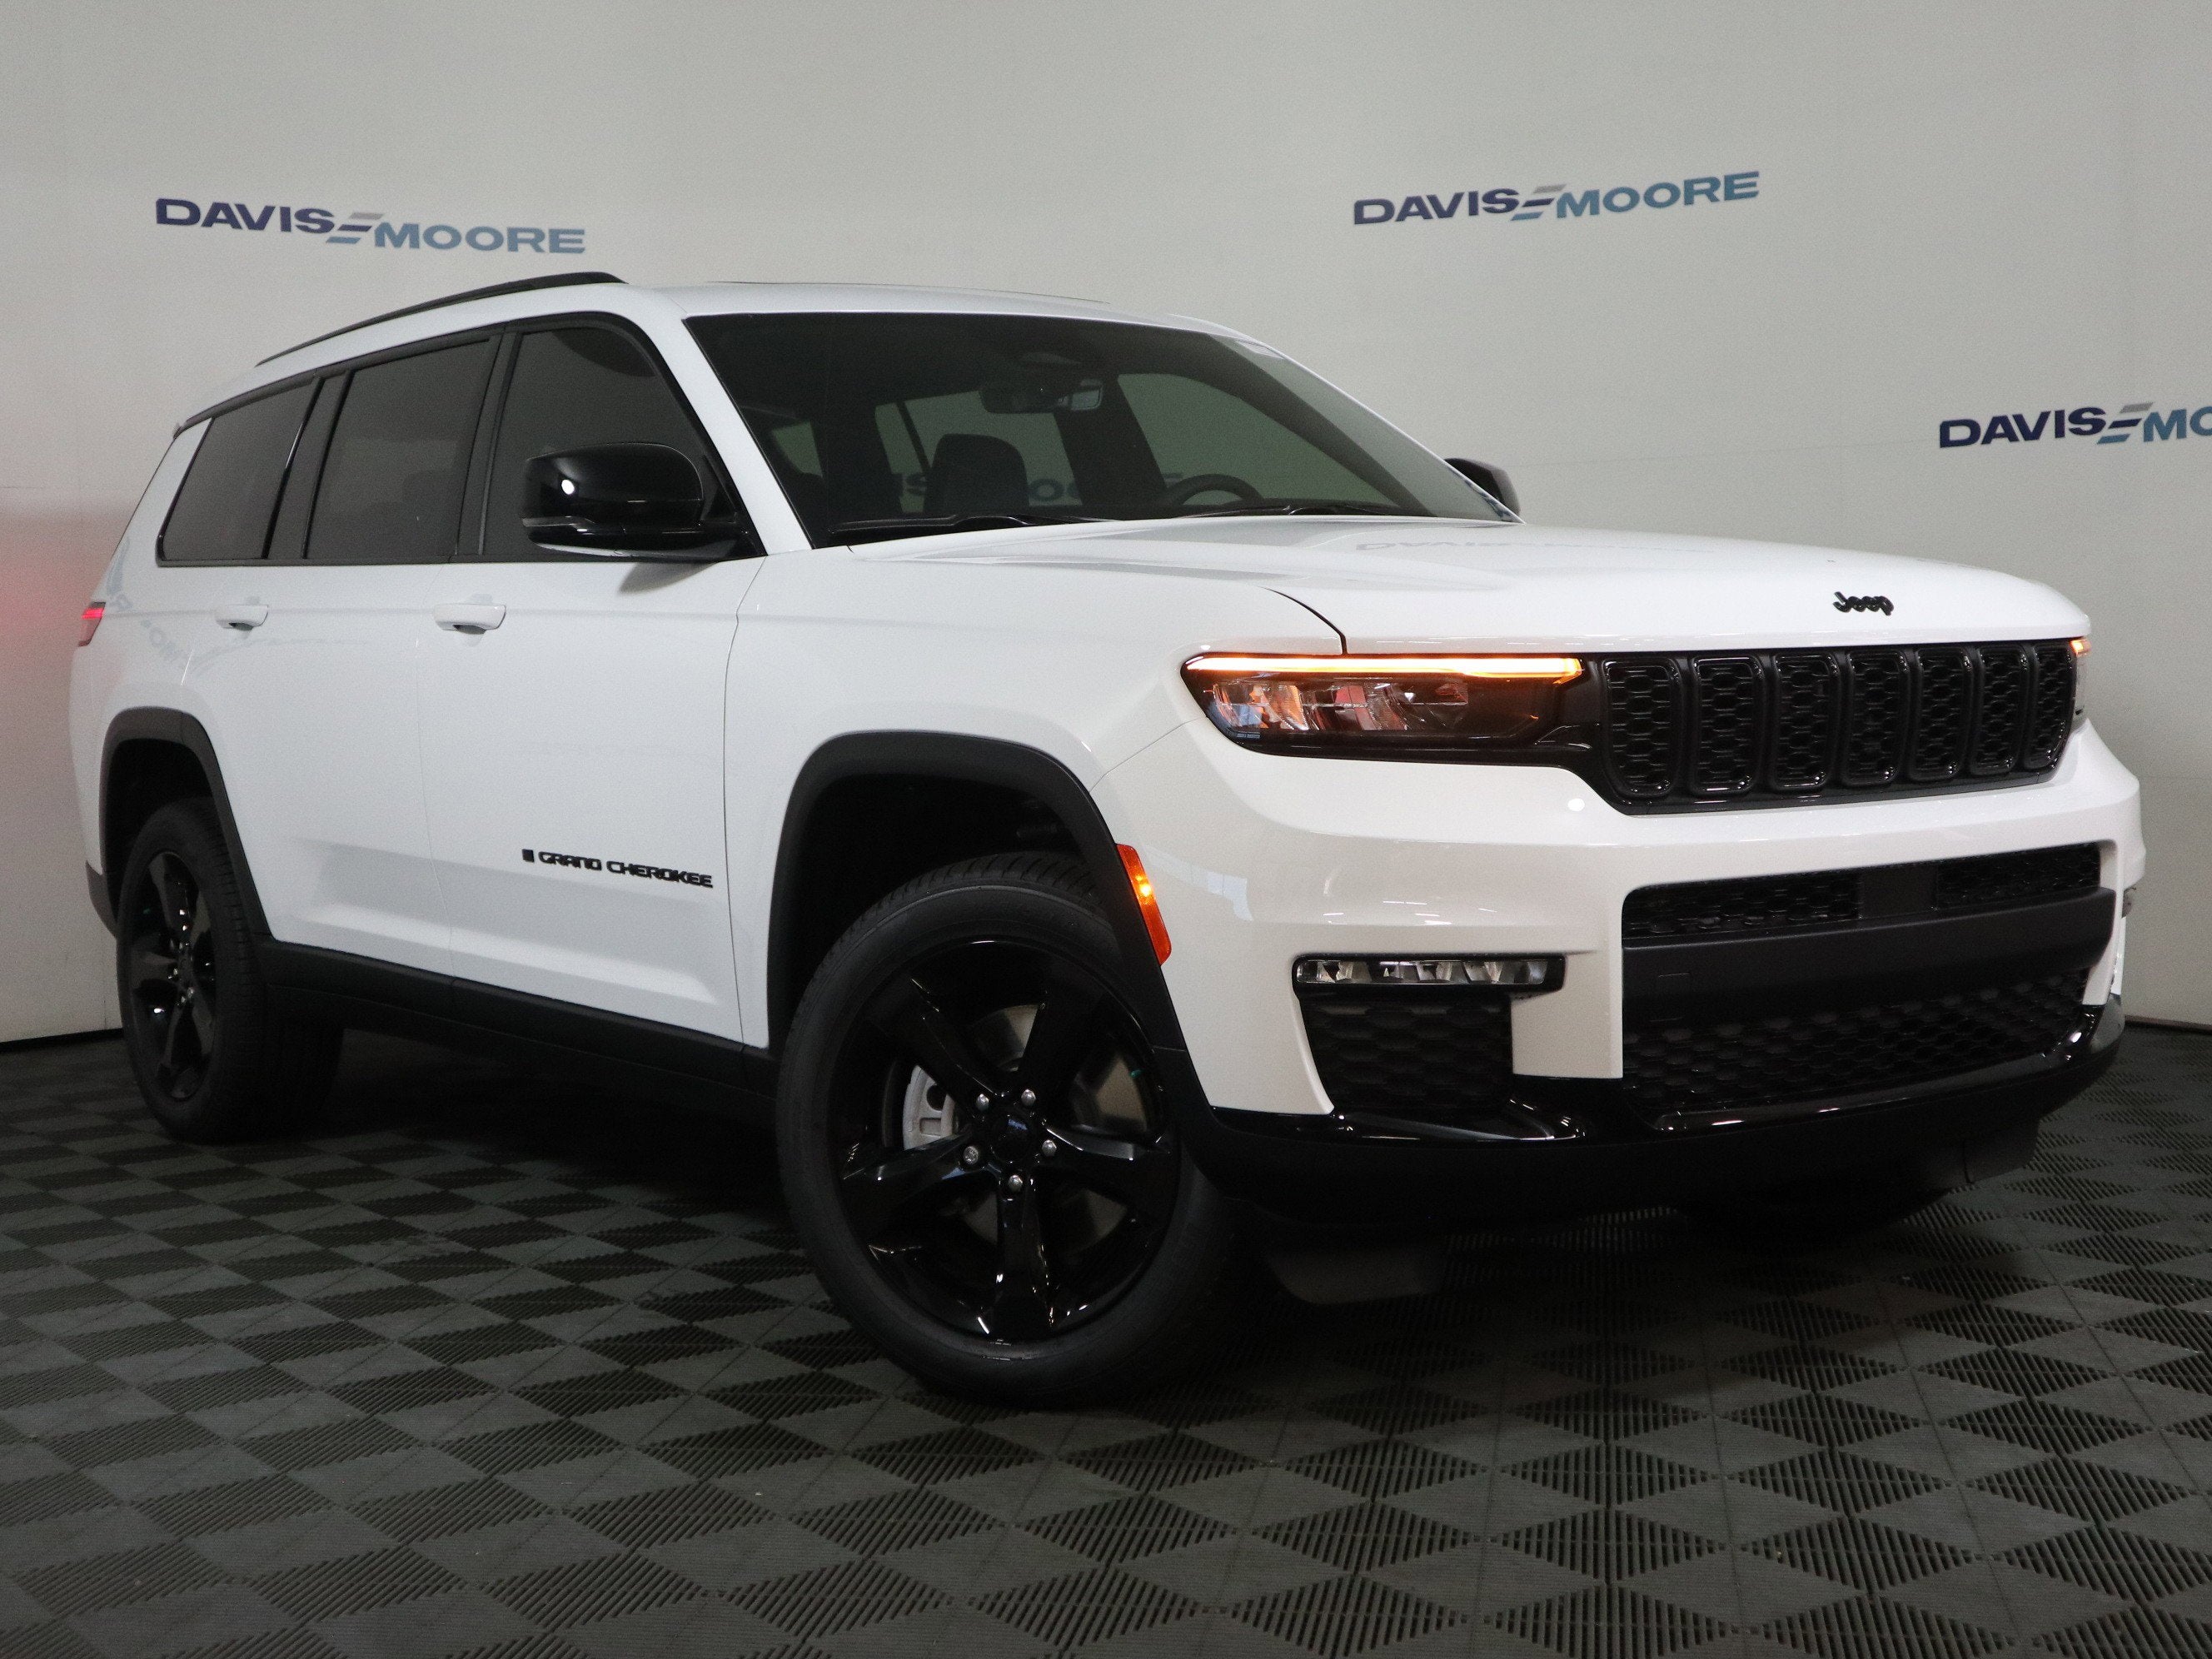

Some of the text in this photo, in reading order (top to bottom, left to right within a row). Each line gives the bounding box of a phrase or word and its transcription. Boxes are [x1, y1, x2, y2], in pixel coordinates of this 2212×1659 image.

[1353, 170, 1760, 226] DAVIS MOORE
[155, 197, 586, 254] DAVIS MOORE
[1939, 406, 2107, 450] DAVIS
[1832, 590, 1895, 616] Jeep
[538, 850, 715, 889] GRAND CHEROKEE
